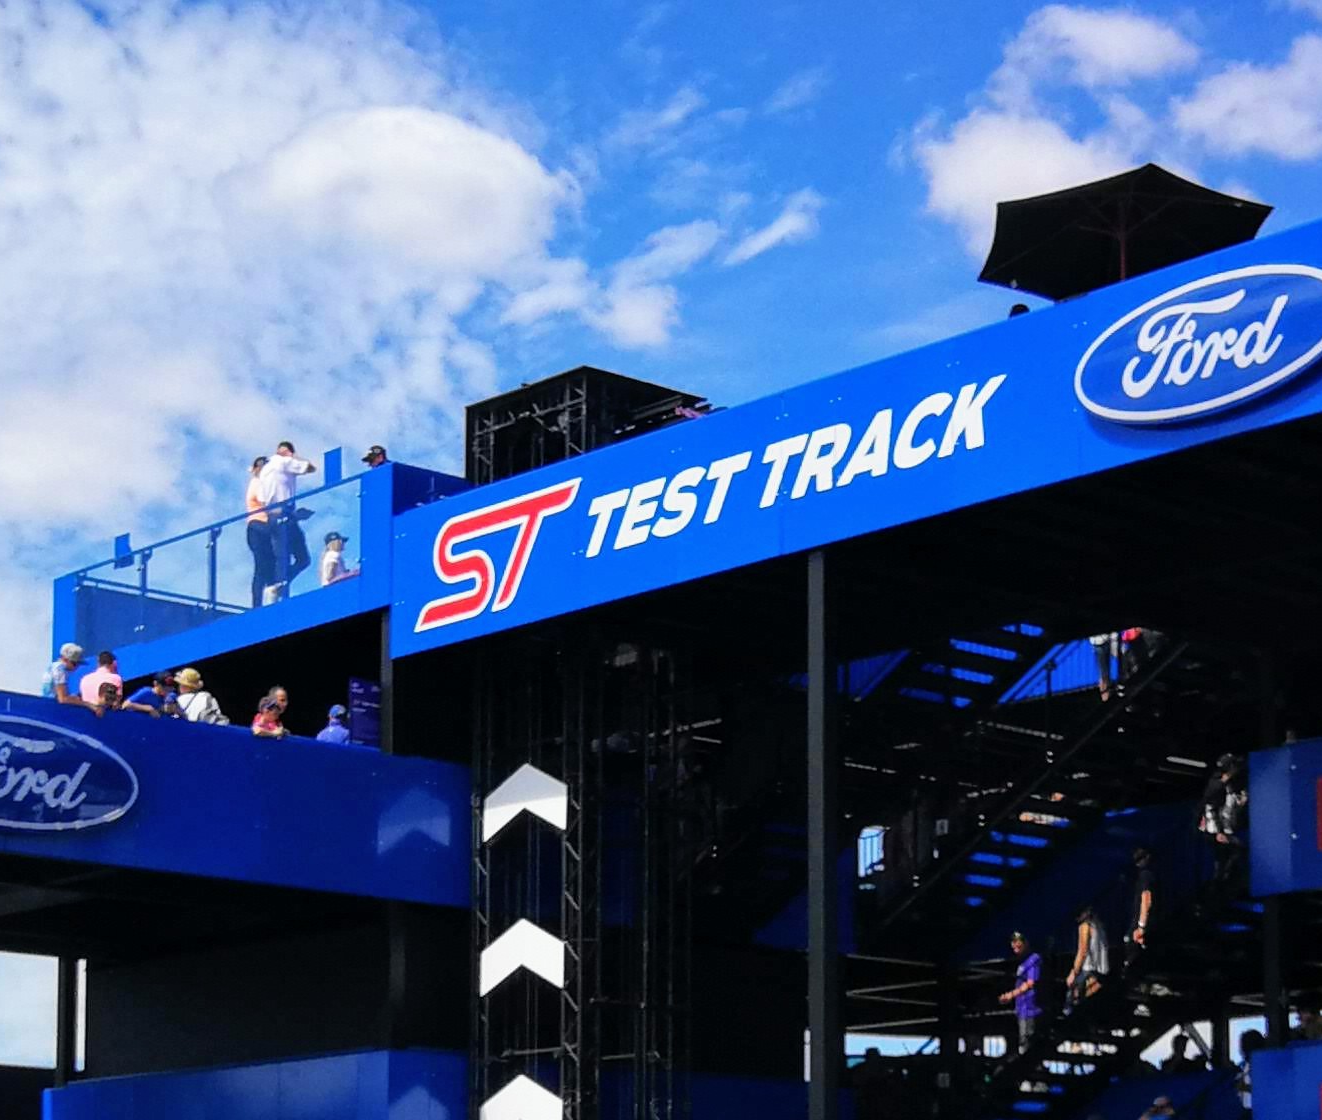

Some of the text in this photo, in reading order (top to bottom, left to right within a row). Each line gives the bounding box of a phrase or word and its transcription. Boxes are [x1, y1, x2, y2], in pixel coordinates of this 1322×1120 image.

[1120, 287, 1290, 400] Ford
[414, 374, 1008, 634] ST TEST TRACK
